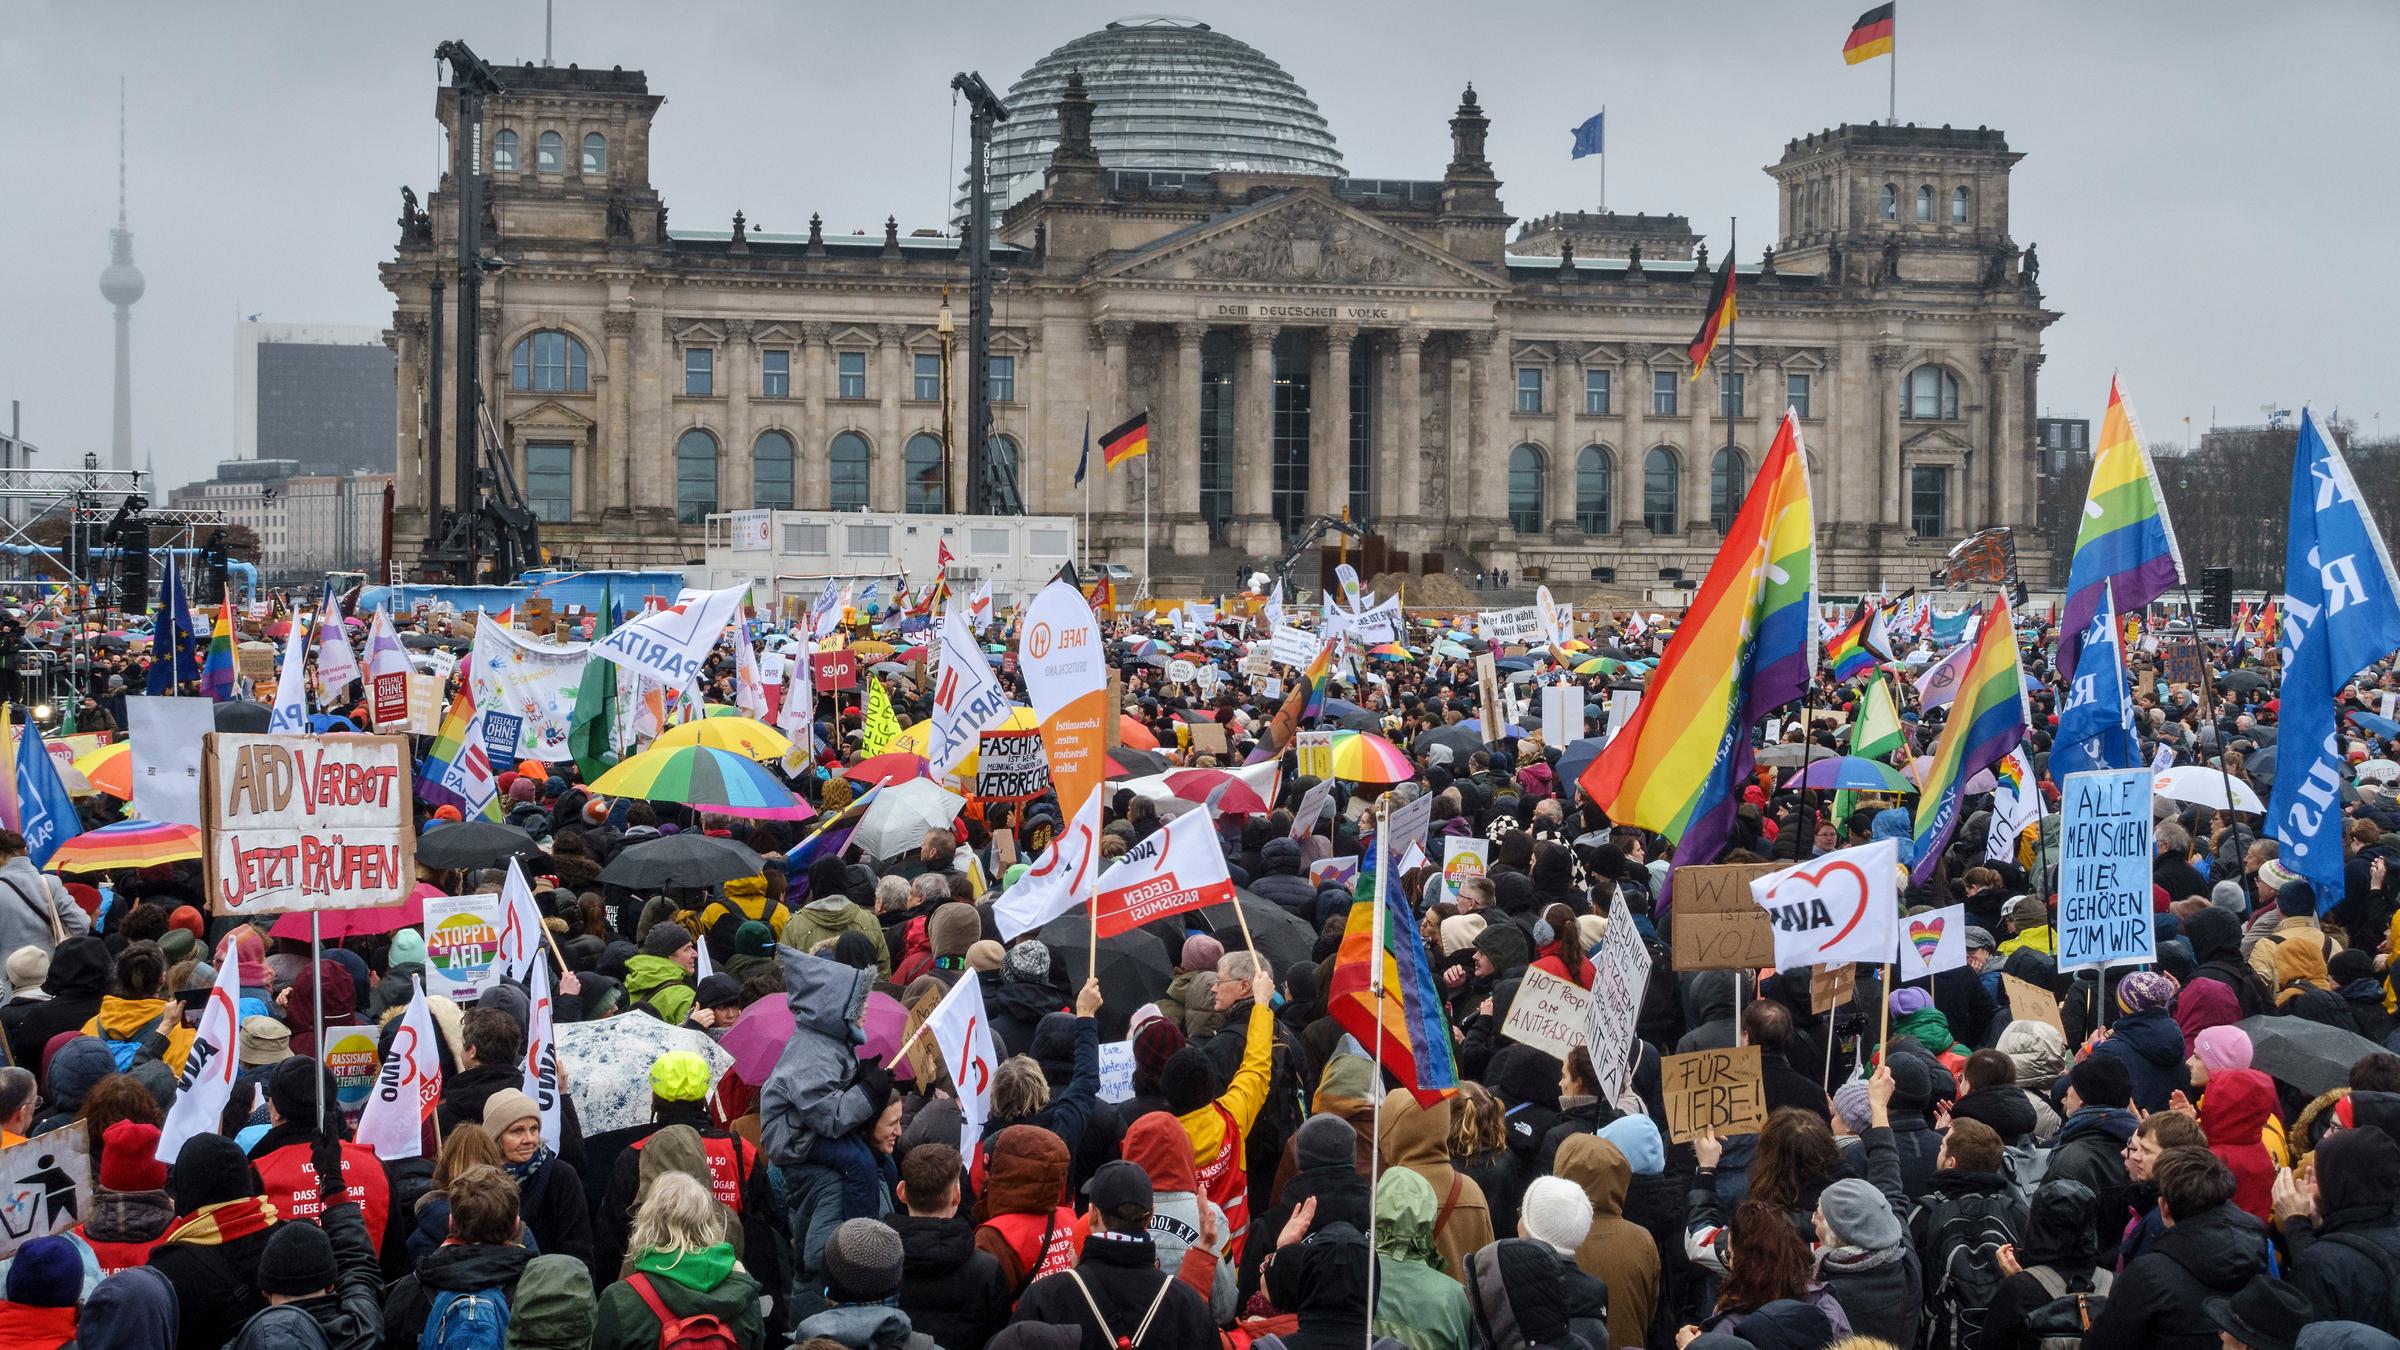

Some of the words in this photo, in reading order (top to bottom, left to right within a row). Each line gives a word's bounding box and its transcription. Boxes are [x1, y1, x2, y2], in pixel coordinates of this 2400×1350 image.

[1218, 304, 1249, 316] DEM
[1260, 305, 1337, 318] DEUTSCHEN
[1349, 308, 1388, 319] VOLKE
[1481, 615, 1498, 626] Wer
[1500, 613, 1513, 624] AfD
[1493, 624, 1516, 637] wählt
[1517, 621, 1539, 635] Nazis!
[377, 675, 403, 685] VIELFALT
[378, 682, 403, 696] OHNE
[489, 714, 519, 729] VIELFALT
[487, 724, 516, 740] OHNE
[229, 744, 293, 817] AFD
[294, 749, 397, 816] VERBOT
[2078, 781, 2135, 818] ALLE
[2066, 820, 2148, 859] MENSCHEN
[223, 835, 299, 907] JETZT
[300, 833, 399, 896] PRÜFEN
[1456, 863, 1481, 874] STIMME
[2076, 863, 2120, 893] HIER
[2066, 891, 2142, 923] GEHÖREN
[432, 923, 489, 948] STOPPT
[1611, 891, 1633, 947] SCHILD
[1630, 943, 1650, 980] NICHT
[2066, 924, 2105, 958] ZUM
[2110, 918, 2148, 952] WIR
[449, 943, 483, 971] AFD
[1527, 972, 1562, 994] HOT
[1538, 998, 1560, 1016] are
[332, 1051, 373, 1066] RASSISMUS
[1679, 1053, 1740, 1090] FÜR
[1673, 1078, 1761, 1137] LIEBE!
[293, 1189, 317, 1201] DASS
[713, 1180, 736, 1190] OGAR
[293, 1202, 319, 1215] DIESE
